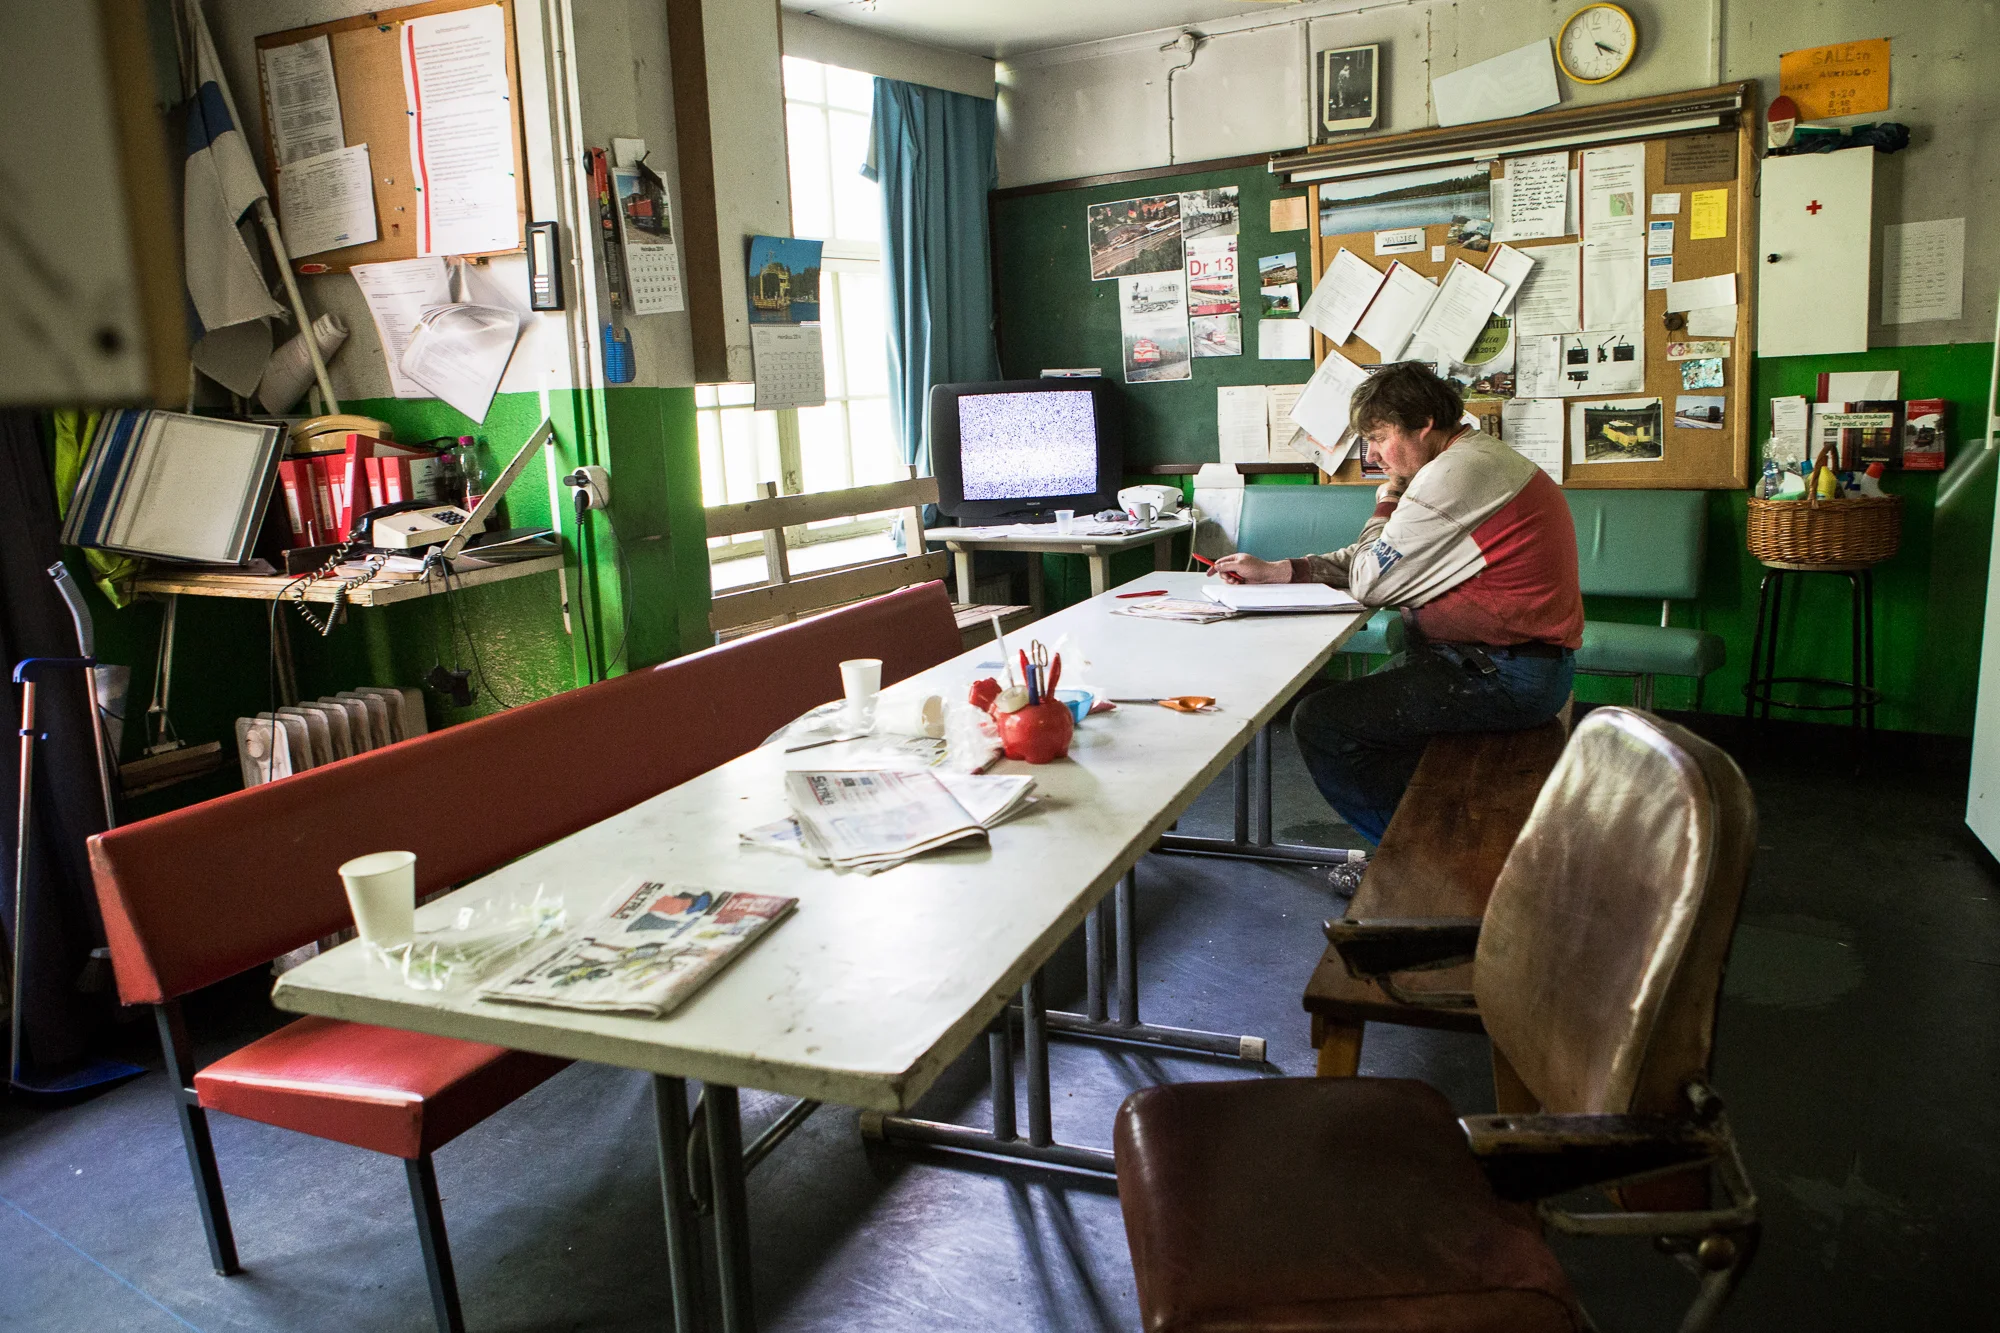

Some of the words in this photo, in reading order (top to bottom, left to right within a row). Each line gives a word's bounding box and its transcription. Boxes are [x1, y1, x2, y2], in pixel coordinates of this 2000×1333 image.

[1592, 11, 1601, 25] 12
[1613, 19, 1622, 33] 2
[1619, 33, 1627, 46] 3
[1572, 56, 1579, 69] 8
[1584, 61, 1591, 75] 7
[1605, 58, 1612, 71] 5
[1189, 259, 1209, 276] Dr
[1215, 256, 1234, 272] 13
[1869, 420, 1884, 428] god
